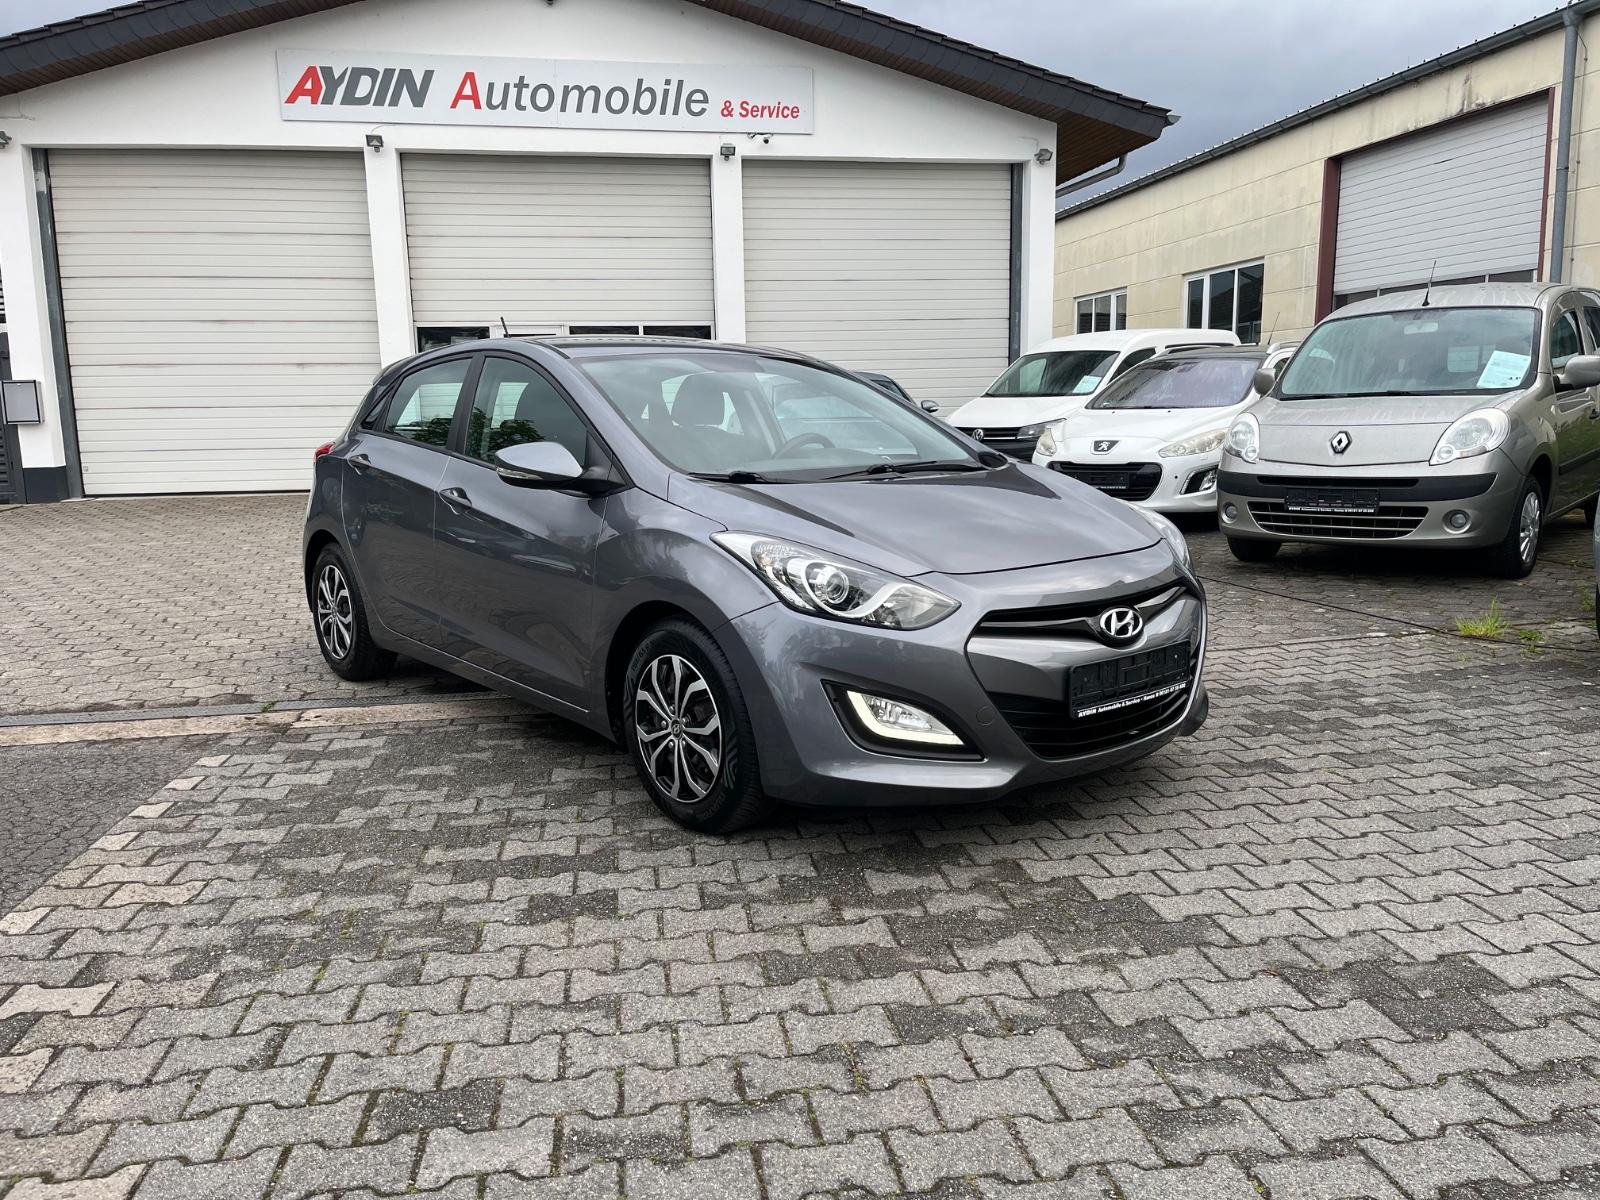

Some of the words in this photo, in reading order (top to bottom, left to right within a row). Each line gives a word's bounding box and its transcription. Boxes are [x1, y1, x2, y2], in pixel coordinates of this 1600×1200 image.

[284, 65, 435, 108] AYDIN
[449, 71, 709, 117] Automobile
[720, 100, 735, 118] &
[738, 100, 800, 119] Service
